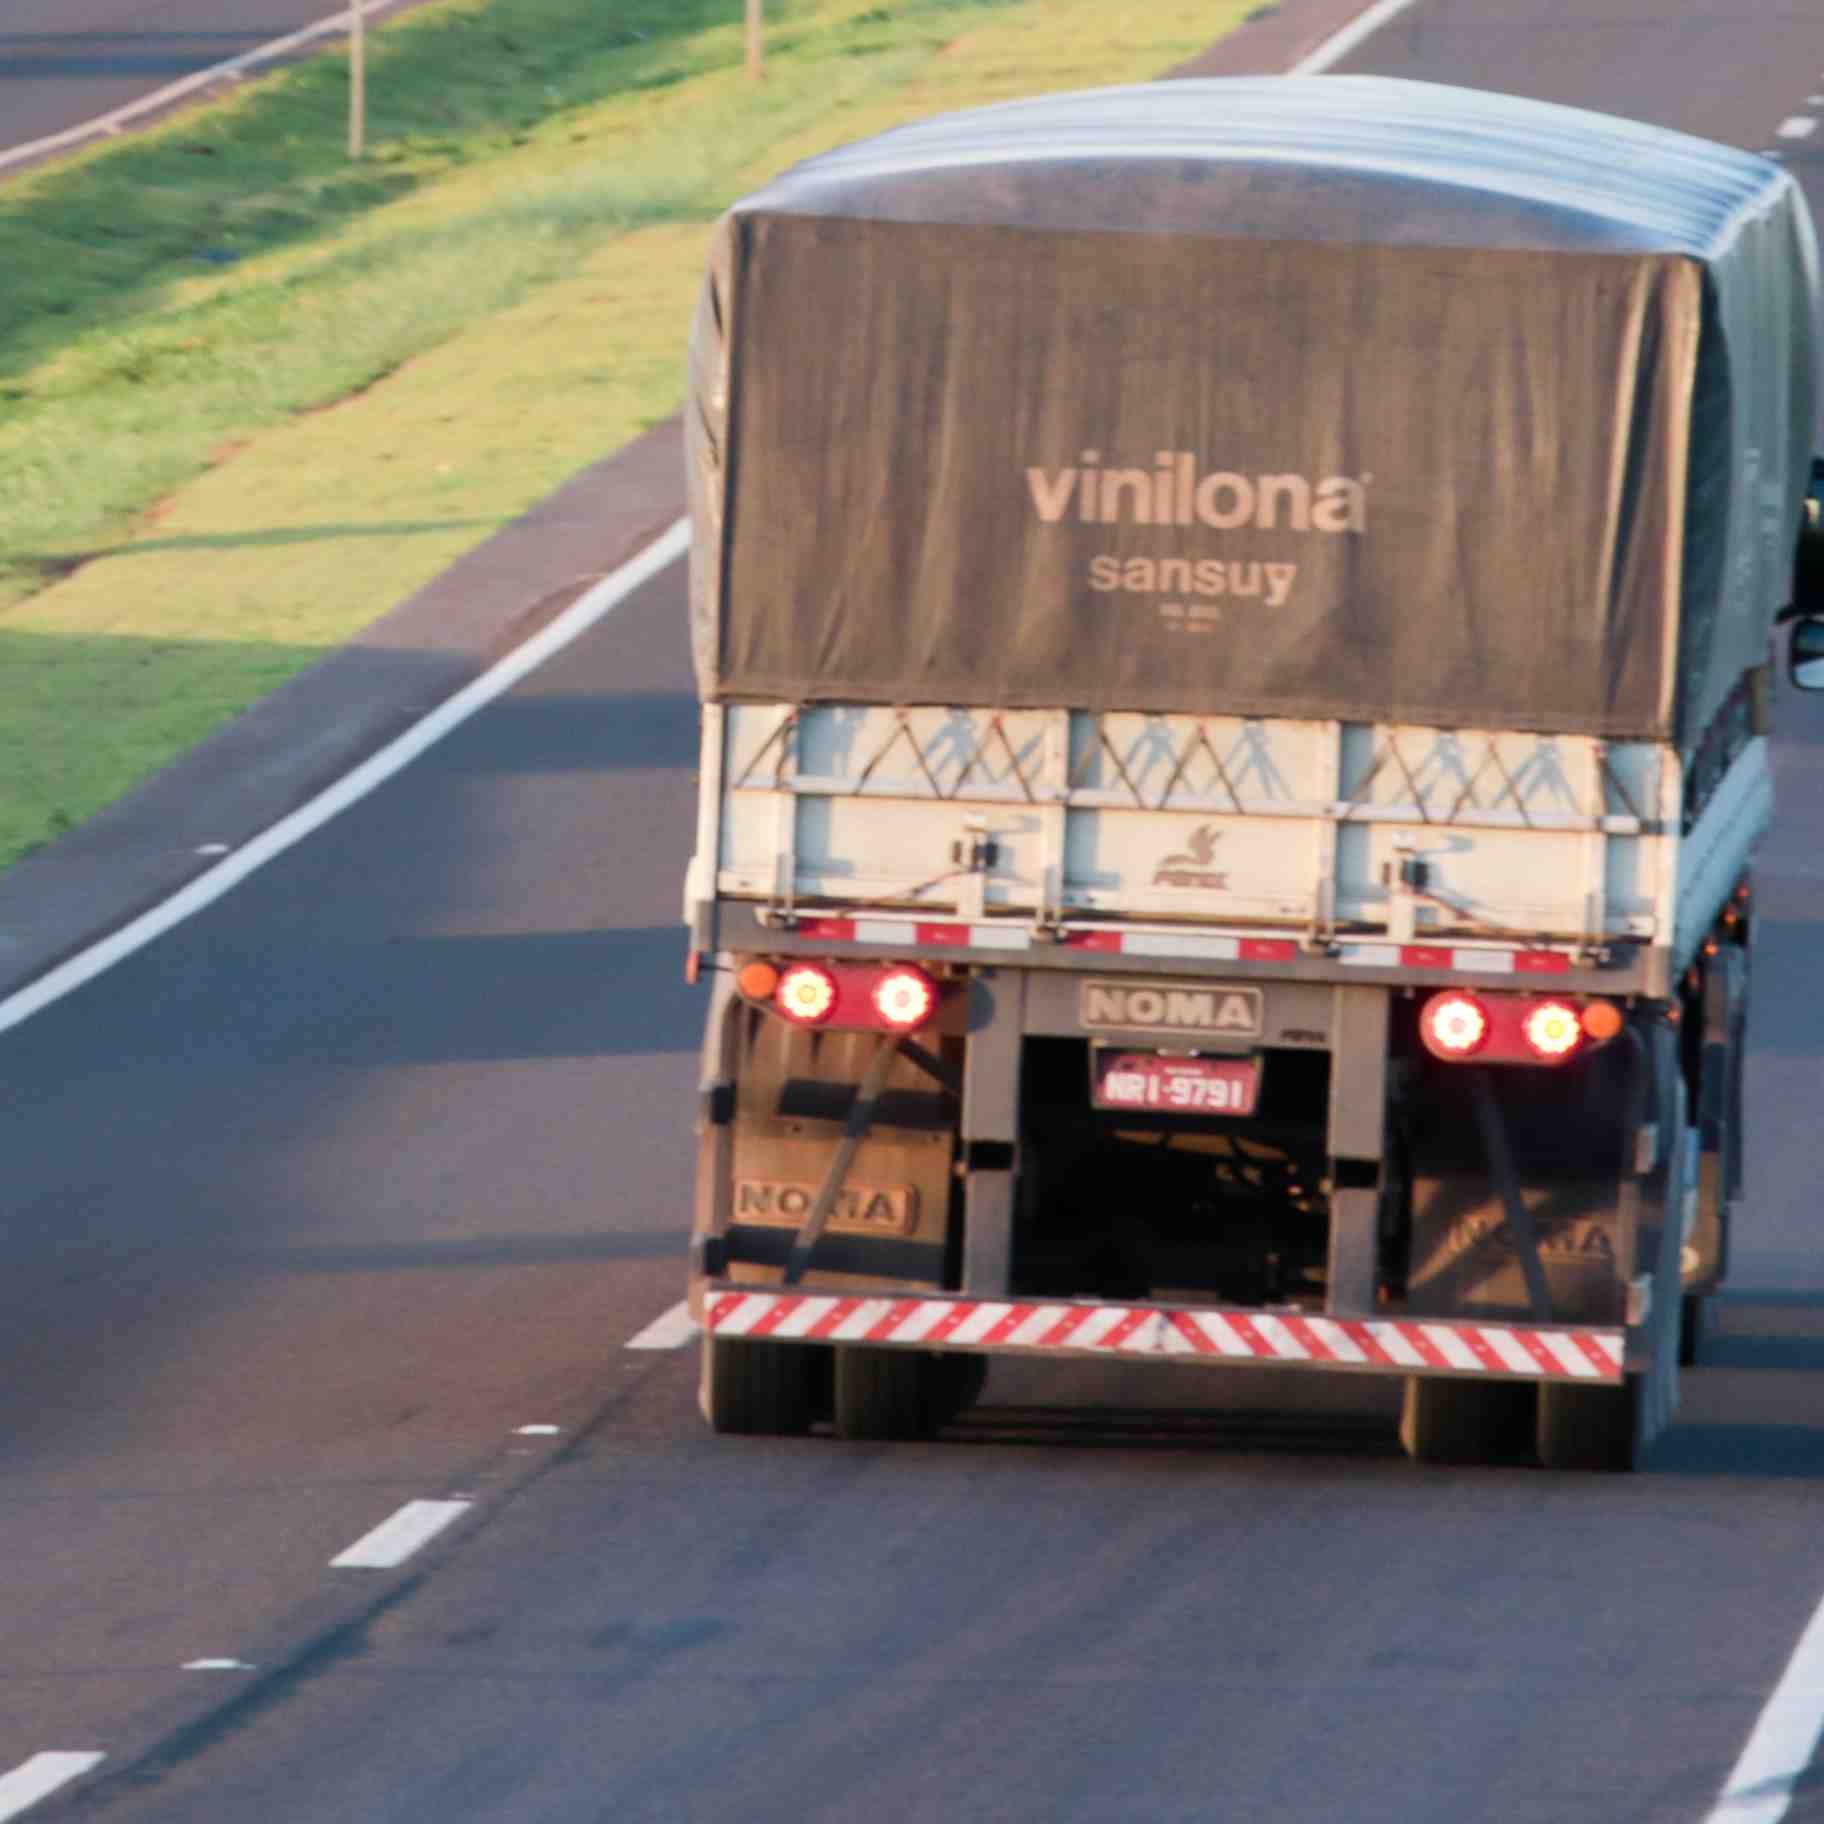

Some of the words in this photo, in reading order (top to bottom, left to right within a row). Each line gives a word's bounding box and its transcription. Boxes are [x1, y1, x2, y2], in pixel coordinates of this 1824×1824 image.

[1026, 448, 1368, 534] vinilona
[1089, 555, 1298, 607] sansuy
[1087, 988, 1253, 1028] NOMA
